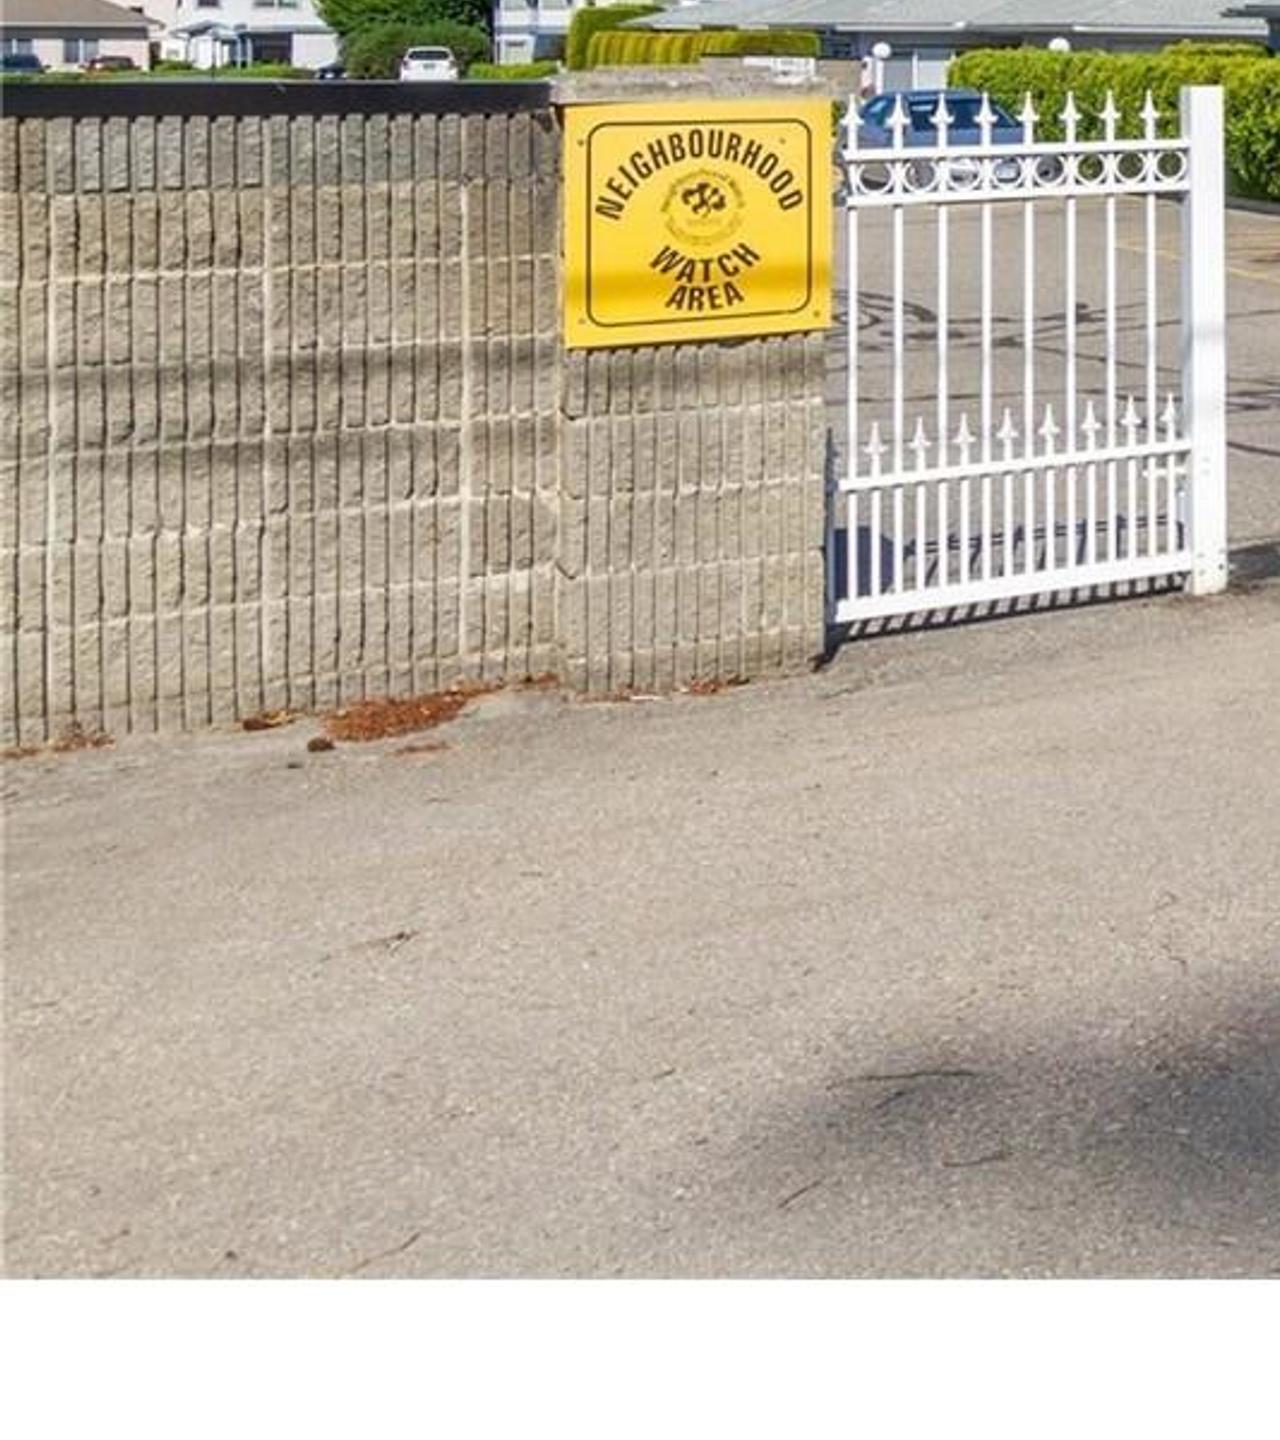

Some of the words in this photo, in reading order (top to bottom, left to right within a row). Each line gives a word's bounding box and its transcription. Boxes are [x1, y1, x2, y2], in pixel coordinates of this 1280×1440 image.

[595, 129, 804, 221] NEIGHBOURHOOD
[649, 242, 761, 283] WATCH
[665, 281, 745, 312] AREA
